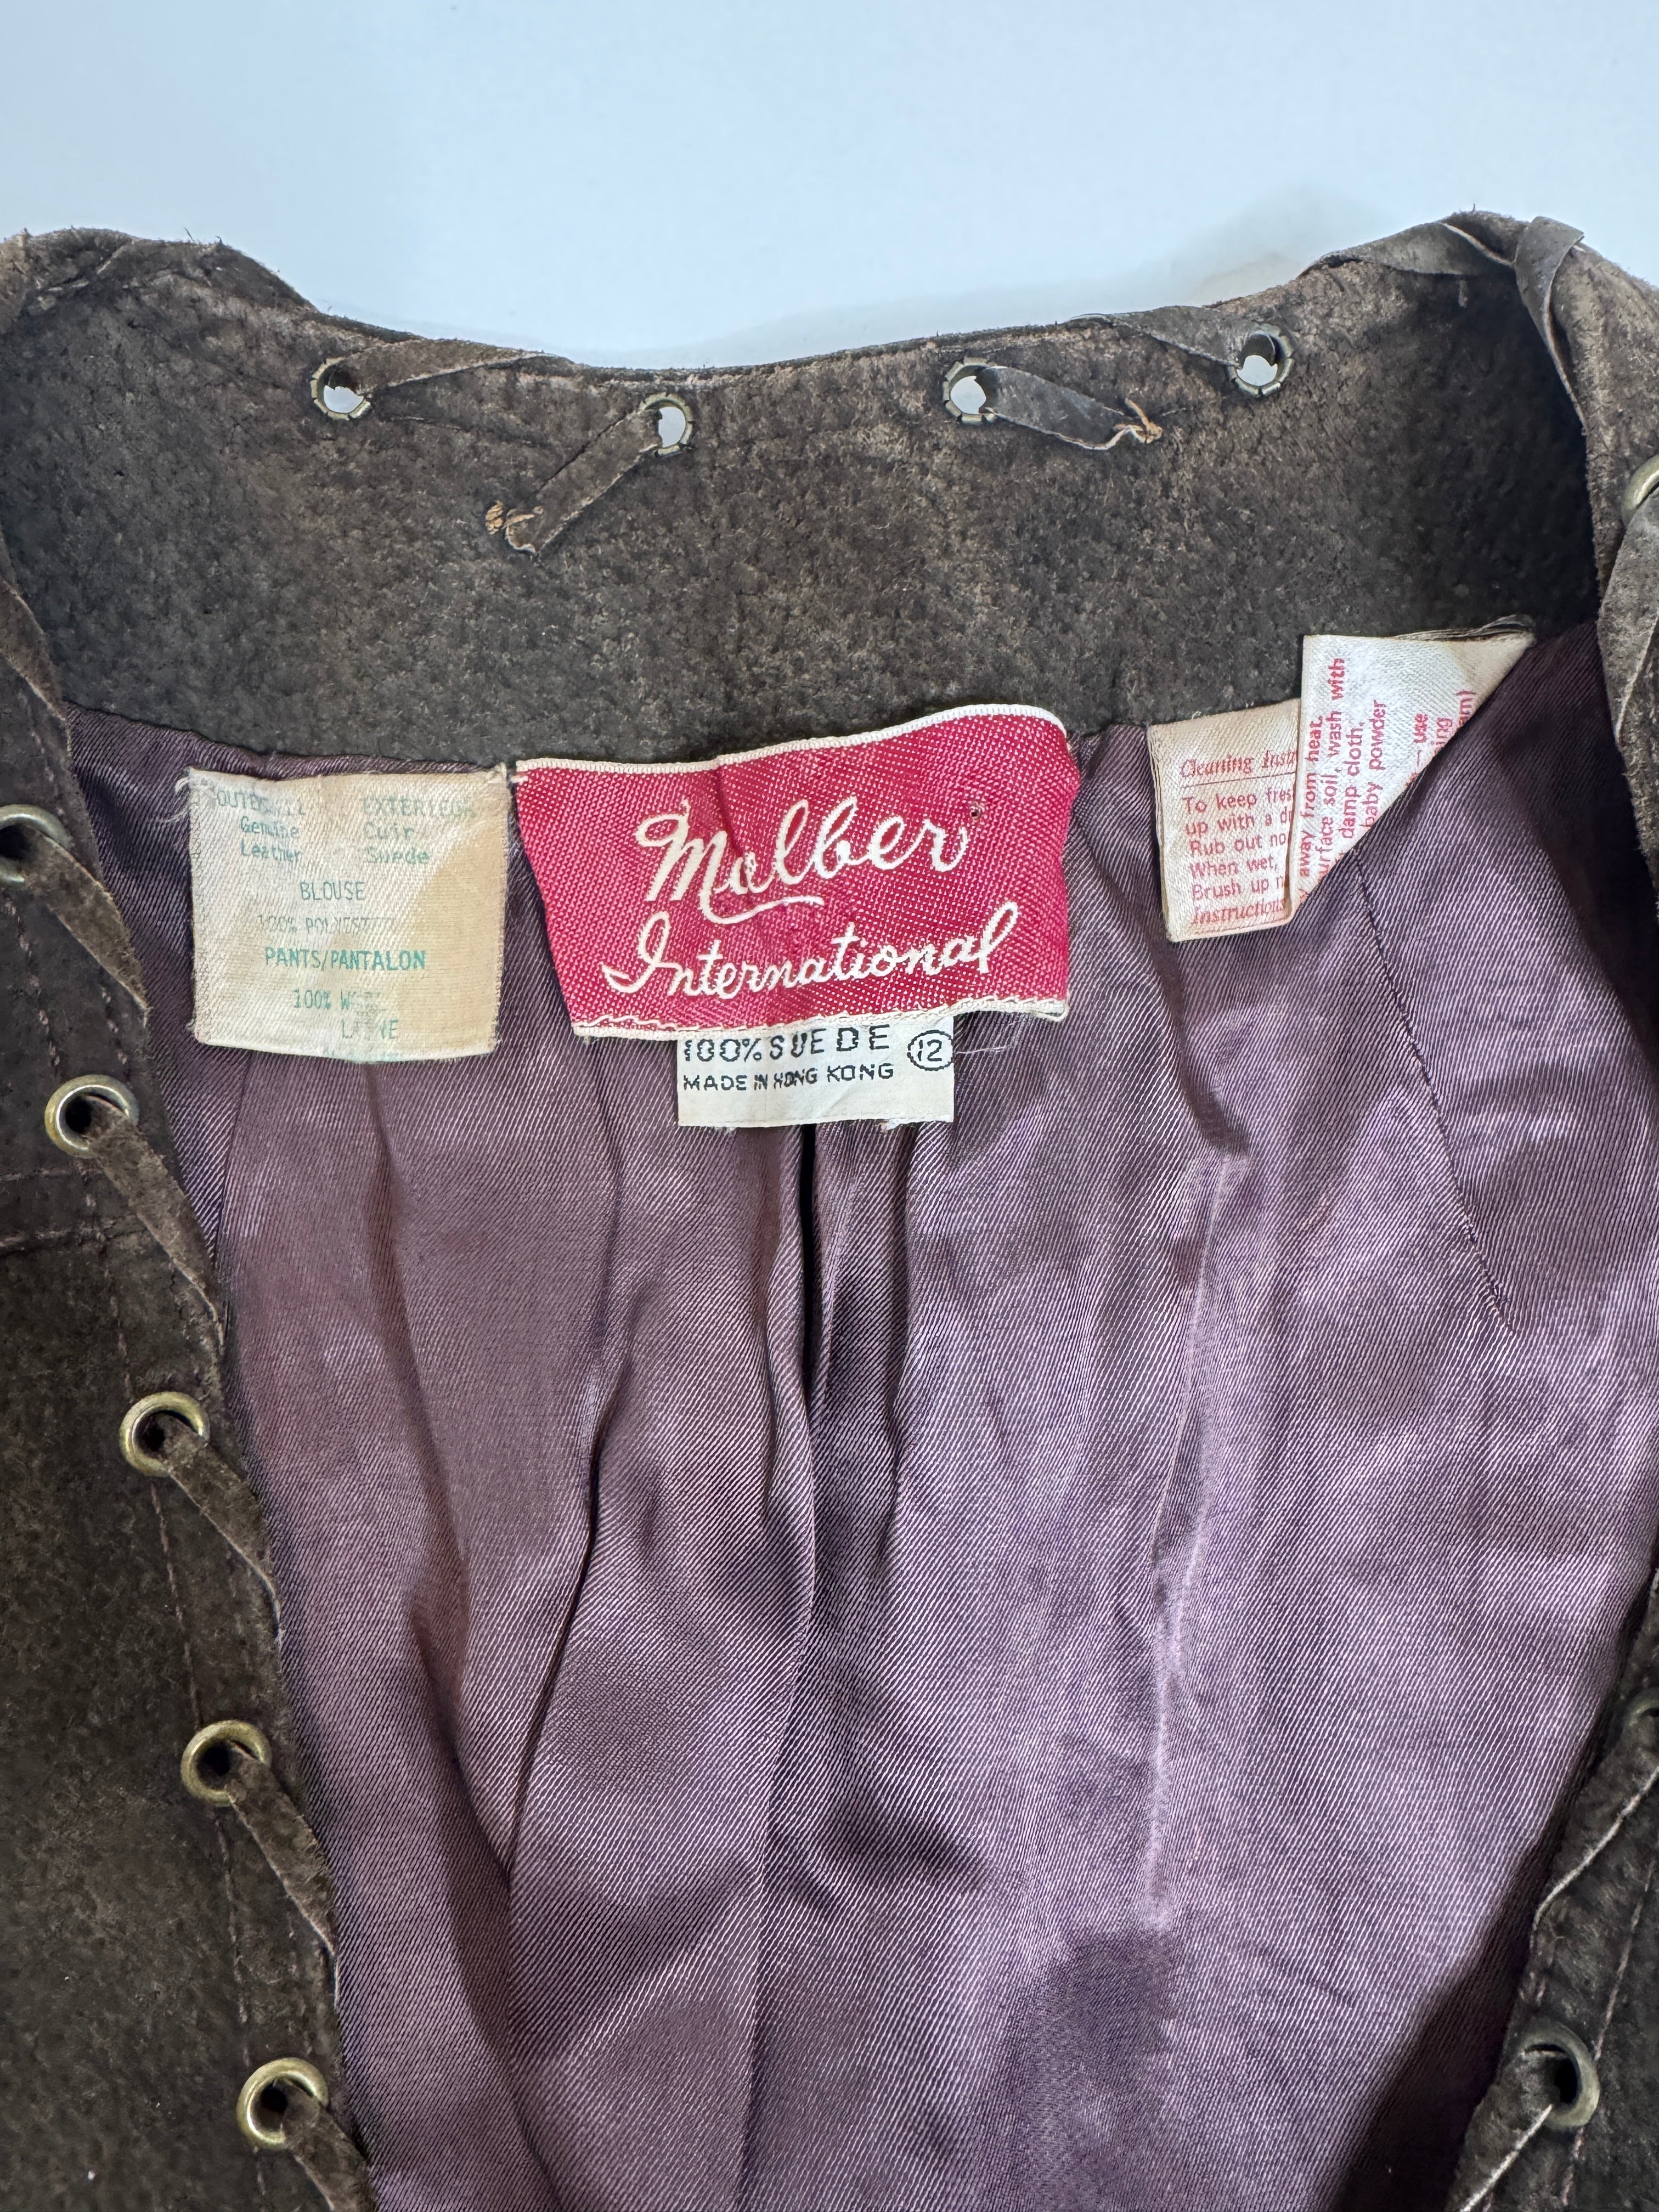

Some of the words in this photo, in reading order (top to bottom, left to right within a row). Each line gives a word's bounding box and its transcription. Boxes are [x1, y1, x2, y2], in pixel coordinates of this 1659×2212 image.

[1327, 658, 1345, 701] with
[1325, 710, 1342, 758] wash
[1368, 699, 1387, 770] powder
[1412, 713, 1429, 743] use
[1343, 722, 1365, 777] cloth.
[1180, 755, 1255, 778] Cleaning
[1300, 772, 1317, 819] from
[1321, 768, 1342, 807] soil,
[1182, 796, 1207, 815] To
[1216, 793, 1257, 811] keep
[1335, 785, 1362, 839] damp
[1358, 781, 1384, 828] baby
[240, 815, 300, 839] Genuine
[1186, 821, 1209, 838] up
[1217, 814, 1255, 831] with
[1265, 813, 1272, 826] a
[240, 838, 302, 862] Leather
[363, 845, 430, 865] Suede
[1189, 838, 1225, 857] Rub
[1234, 834, 1262, 852] out
[1269, 833, 1286, 848] no
[1299, 829, 1316, 877] away
[1314, 816, 1334, 881] urface
[1189, 861, 1239, 879] When
[1246, 854, 1278, 873] wet,
[299, 881, 366, 901] BLOUSE
[1192, 878, 1242, 901] Brush
[1251, 878, 1269, 895] up
[264, 945, 427, 972] PANTS/PANTALON
[601, 901, 1019, 1000] International
[293, 988, 332, 1009] 100%
[684, 1039, 762, 1062] 100%
[683, 1074, 747, 1091] MADE
[754, 1074, 768, 1091] IN
[772, 1067, 818, 1090] HONG
[827, 1062, 894, 1082] KONG
